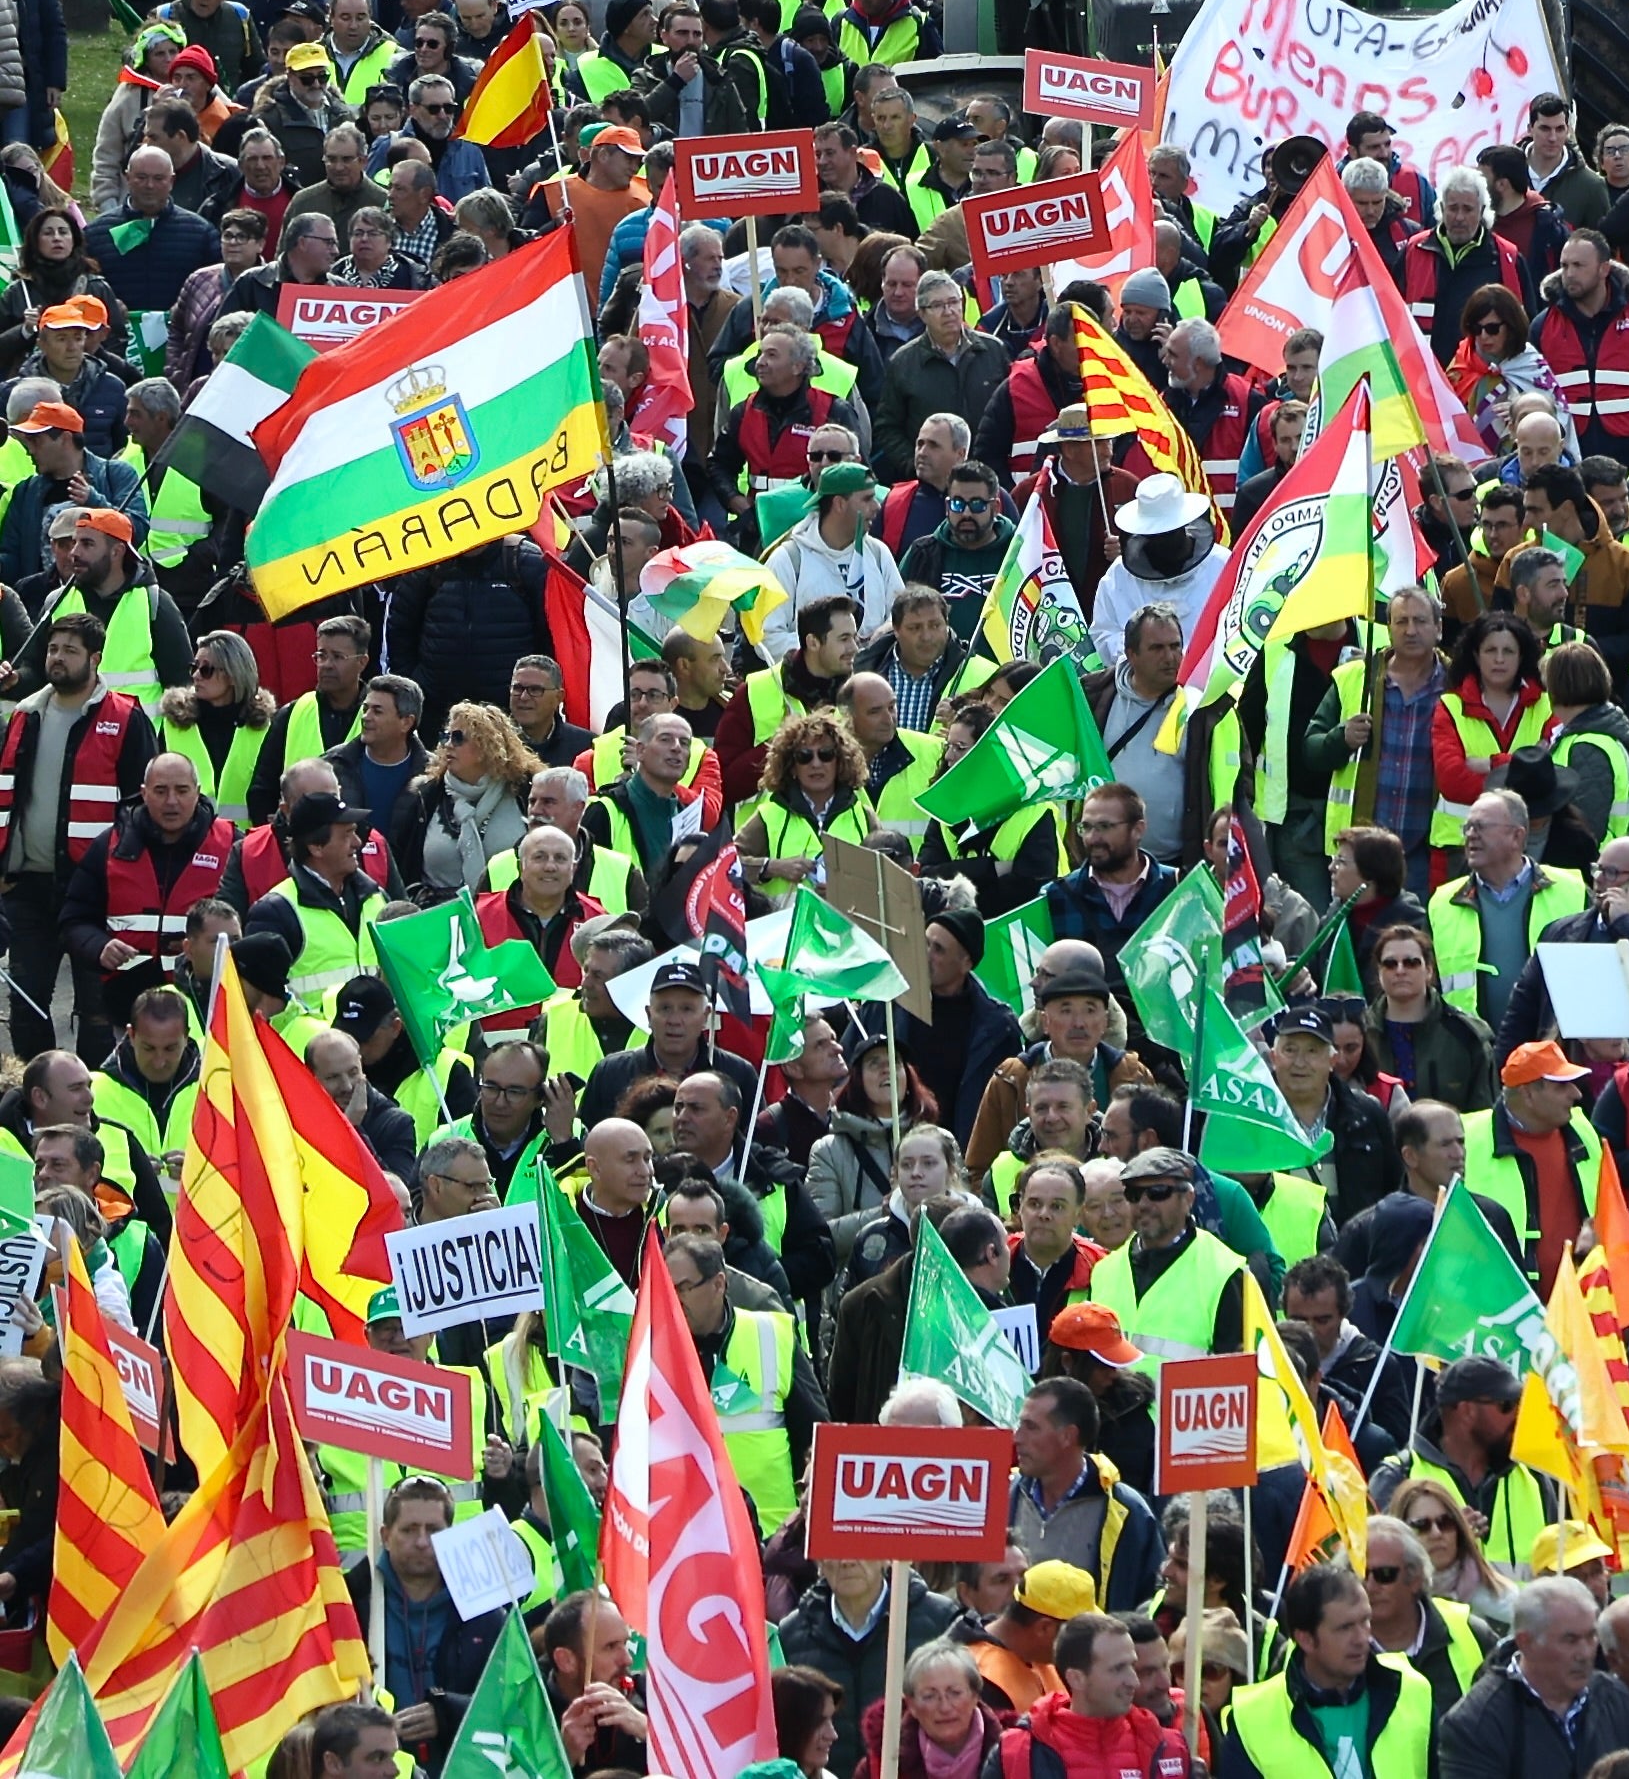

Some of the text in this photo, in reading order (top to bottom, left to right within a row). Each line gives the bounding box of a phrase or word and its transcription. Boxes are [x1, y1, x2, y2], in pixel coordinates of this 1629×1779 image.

[1043, 68, 1138, 103] UAGN
[695, 150, 798, 181] UAGN
[983, 192, 1089, 239] UAGN
[1243, 304, 1286, 331] UNIÓN
[396, 1222, 544, 1314] ¡JUSTICIA!
[116, 1349, 156, 1402] GN
[310, 1359, 447, 1423] UAGN
[1172, 1391, 1245, 1431] UAGN
[841, 1461, 983, 1503] UAGN
